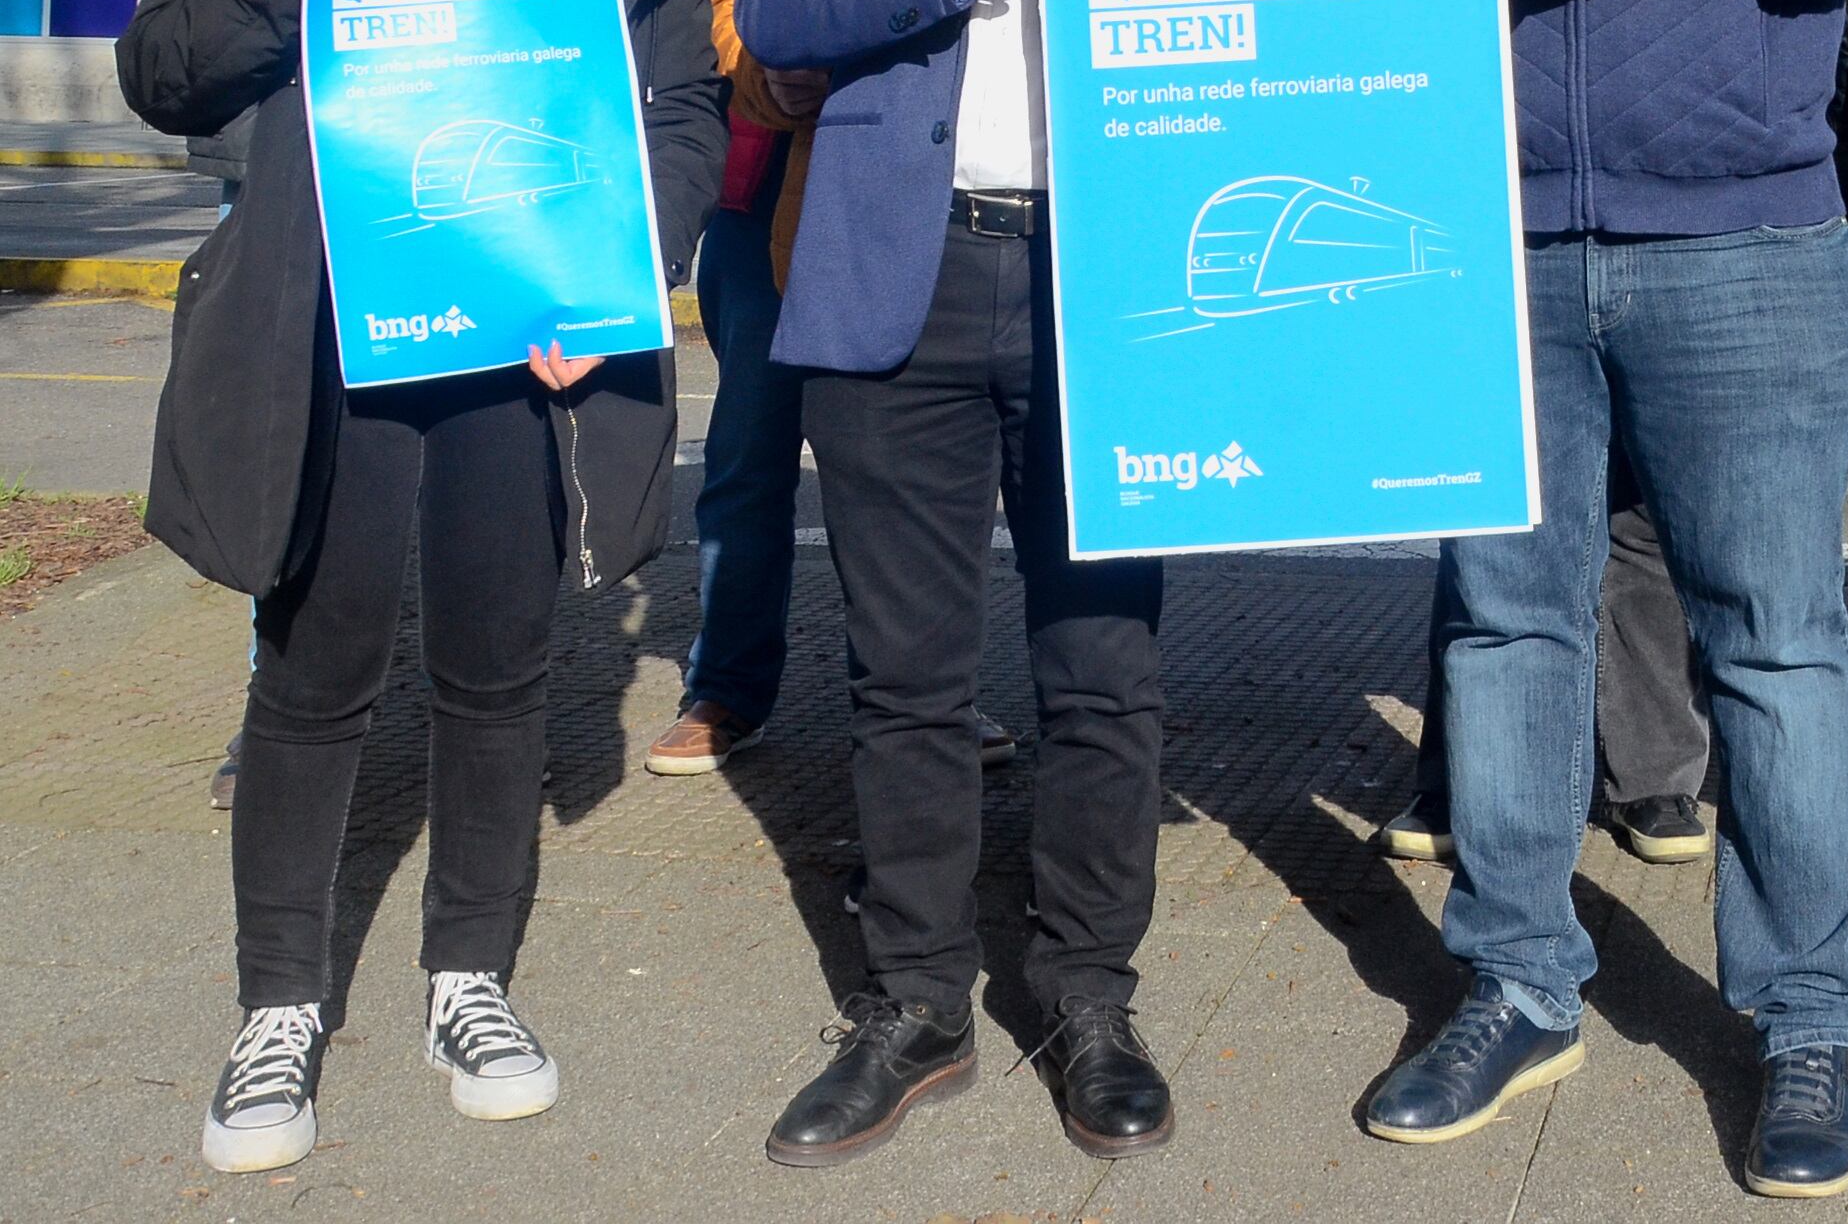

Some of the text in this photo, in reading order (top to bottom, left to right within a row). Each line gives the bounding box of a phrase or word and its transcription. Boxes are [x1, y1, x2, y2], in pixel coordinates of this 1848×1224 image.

[340, 10, 449, 42] TREN!
[1100, 13, 1245, 56] TREN!
[343, 62, 369, 77] Por
[374, 56, 414, 75] unha
[453, 48, 529, 68] ferroviaria
[532, 45, 582, 64] galega
[346, 78, 439, 100] de calidade.
[1103, 70, 1429, 105] Por unha rede ferroviaria galega
[1104, 113, 1227, 137] de calidade.
[365, 313, 430, 343] bng
[1113, 445, 1198, 491] bng
[1371, 472, 1482, 490] #QueremosTrenGZ
